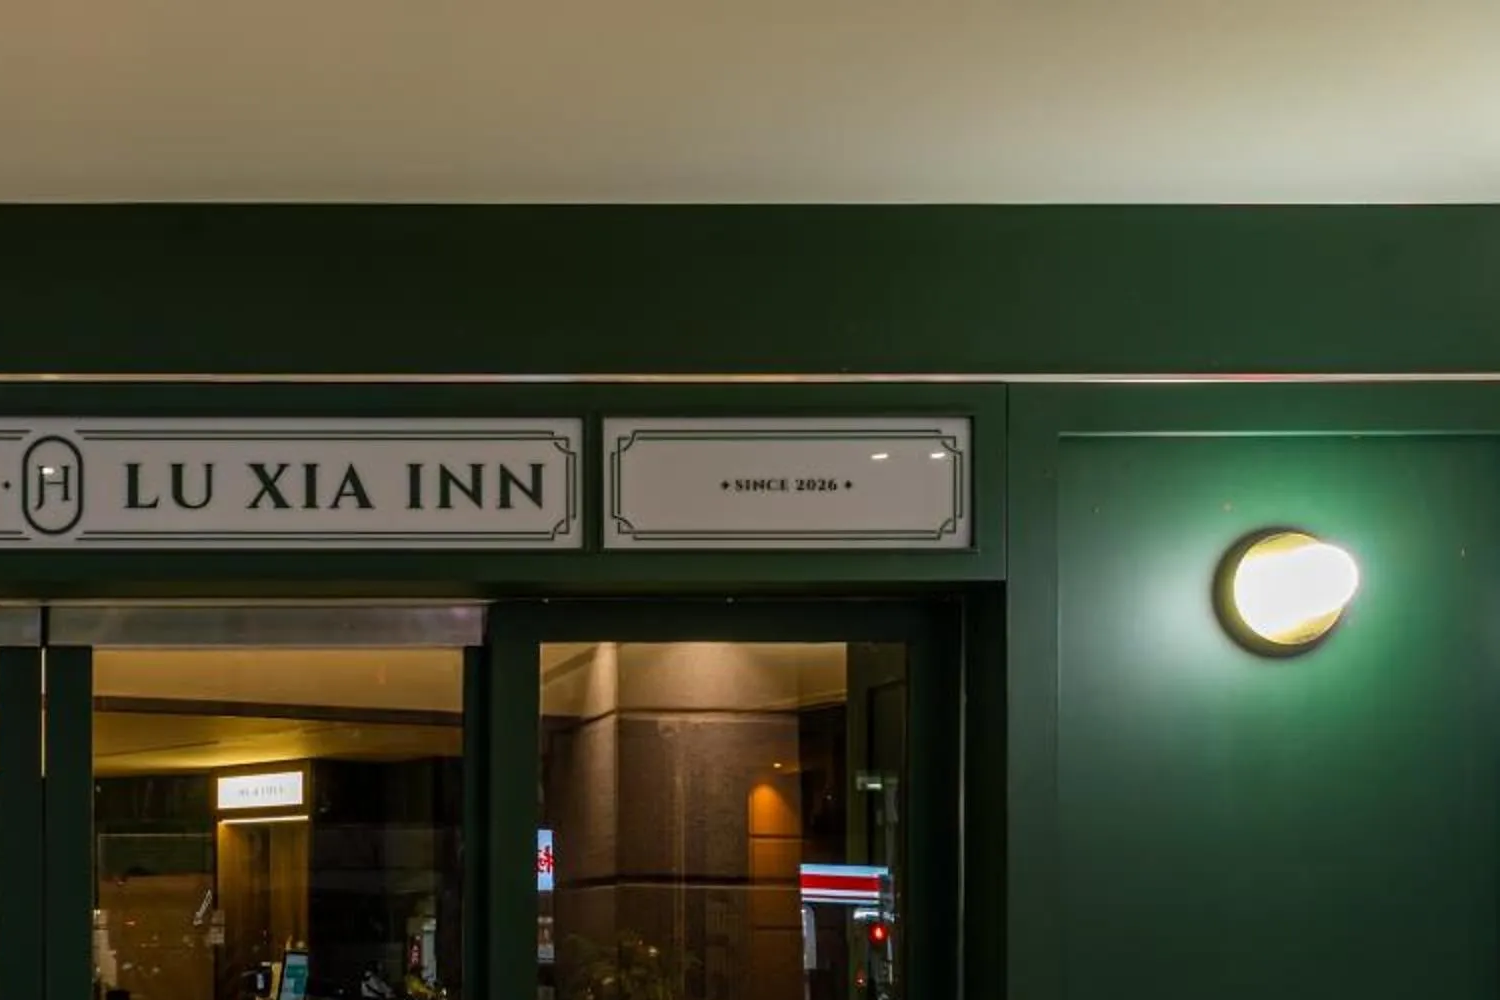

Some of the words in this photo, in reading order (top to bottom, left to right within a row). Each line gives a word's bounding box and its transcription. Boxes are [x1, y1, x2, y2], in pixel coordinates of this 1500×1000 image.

[124, 462, 214, 510] LU
[245, 462, 376, 510] XIA
[406, 462, 545, 510] INN
[734, 478, 789, 492] SINCE
